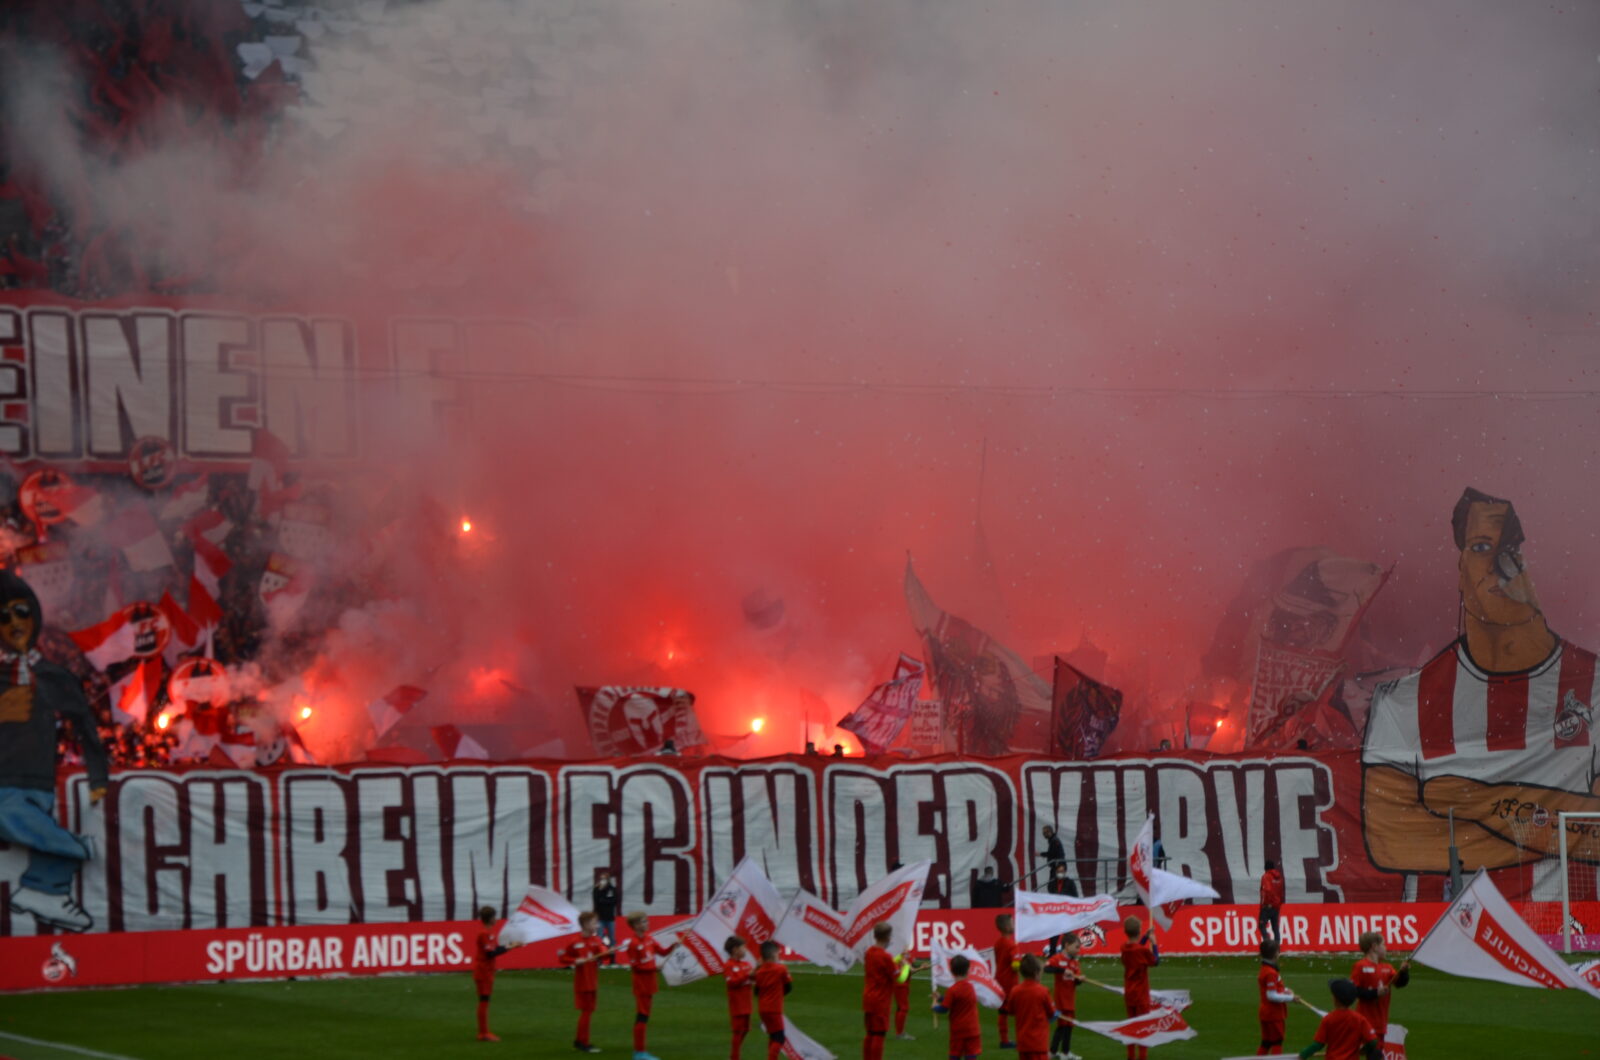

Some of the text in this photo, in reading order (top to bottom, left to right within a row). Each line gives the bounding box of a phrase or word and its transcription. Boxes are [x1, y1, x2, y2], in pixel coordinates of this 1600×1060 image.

[568, 772, 678, 917] FC
[706, 771, 808, 912] IN
[1028, 765, 1326, 904] KURVE
[1190, 911, 1310, 947] SPÜRAR
[206, 932, 472, 974] SPÜRBAR ANDERS.
